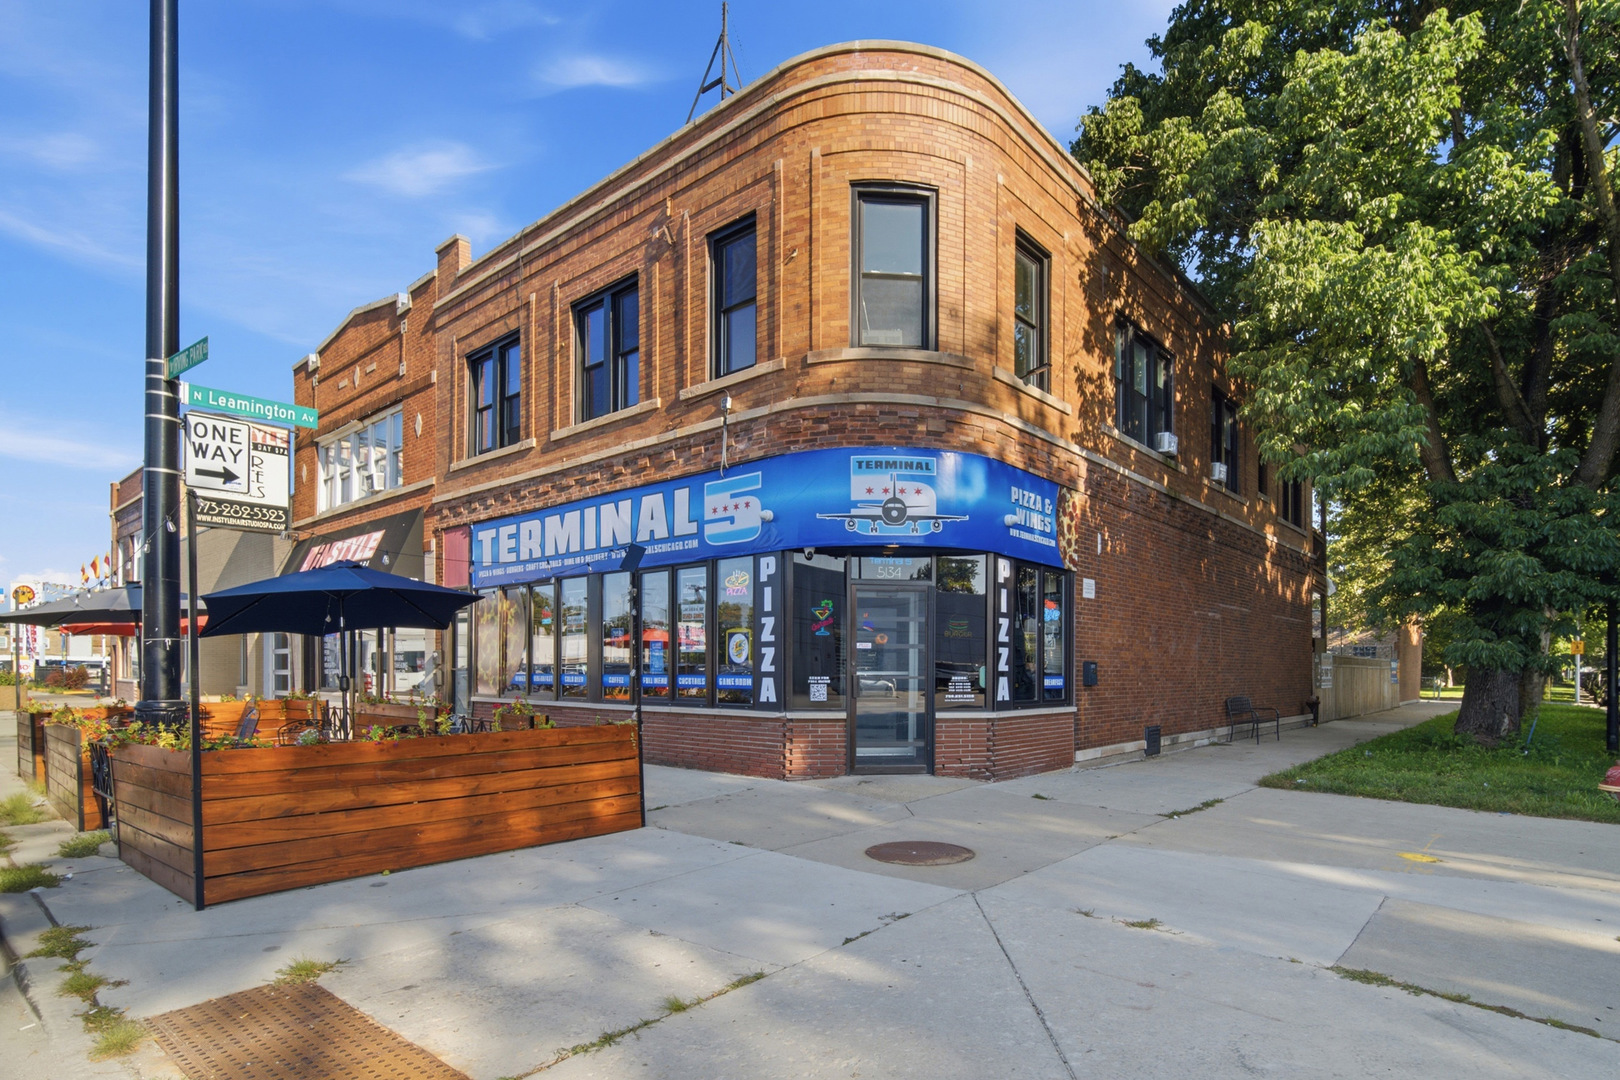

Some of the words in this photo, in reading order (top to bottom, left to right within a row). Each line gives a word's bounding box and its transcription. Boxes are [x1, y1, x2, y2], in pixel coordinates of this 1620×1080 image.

[193, 390, 202, 401] N
[208, 391, 296, 420] Leamington
[301, 413, 315, 423] Av
[193, 422, 242, 445] ONE
[192, 441, 243, 464] WAY
[856, 460, 932, 472] TERMINAL
[1011, 486, 1042, 512] PIZZA
[1044, 498, 1053, 515] &
[477, 486, 698, 567] TERMINAL
[703, 471, 762, 546] 5
[1015, 507, 1051, 533] WINGS
[877, 566, 902, 579] 5134
[726, 586, 748, 596] PIZZA
[759, 556, 777, 702] PIZZA
[997, 558, 1010, 701] PIZZA
[608, 676, 624, 684] COFFEE
